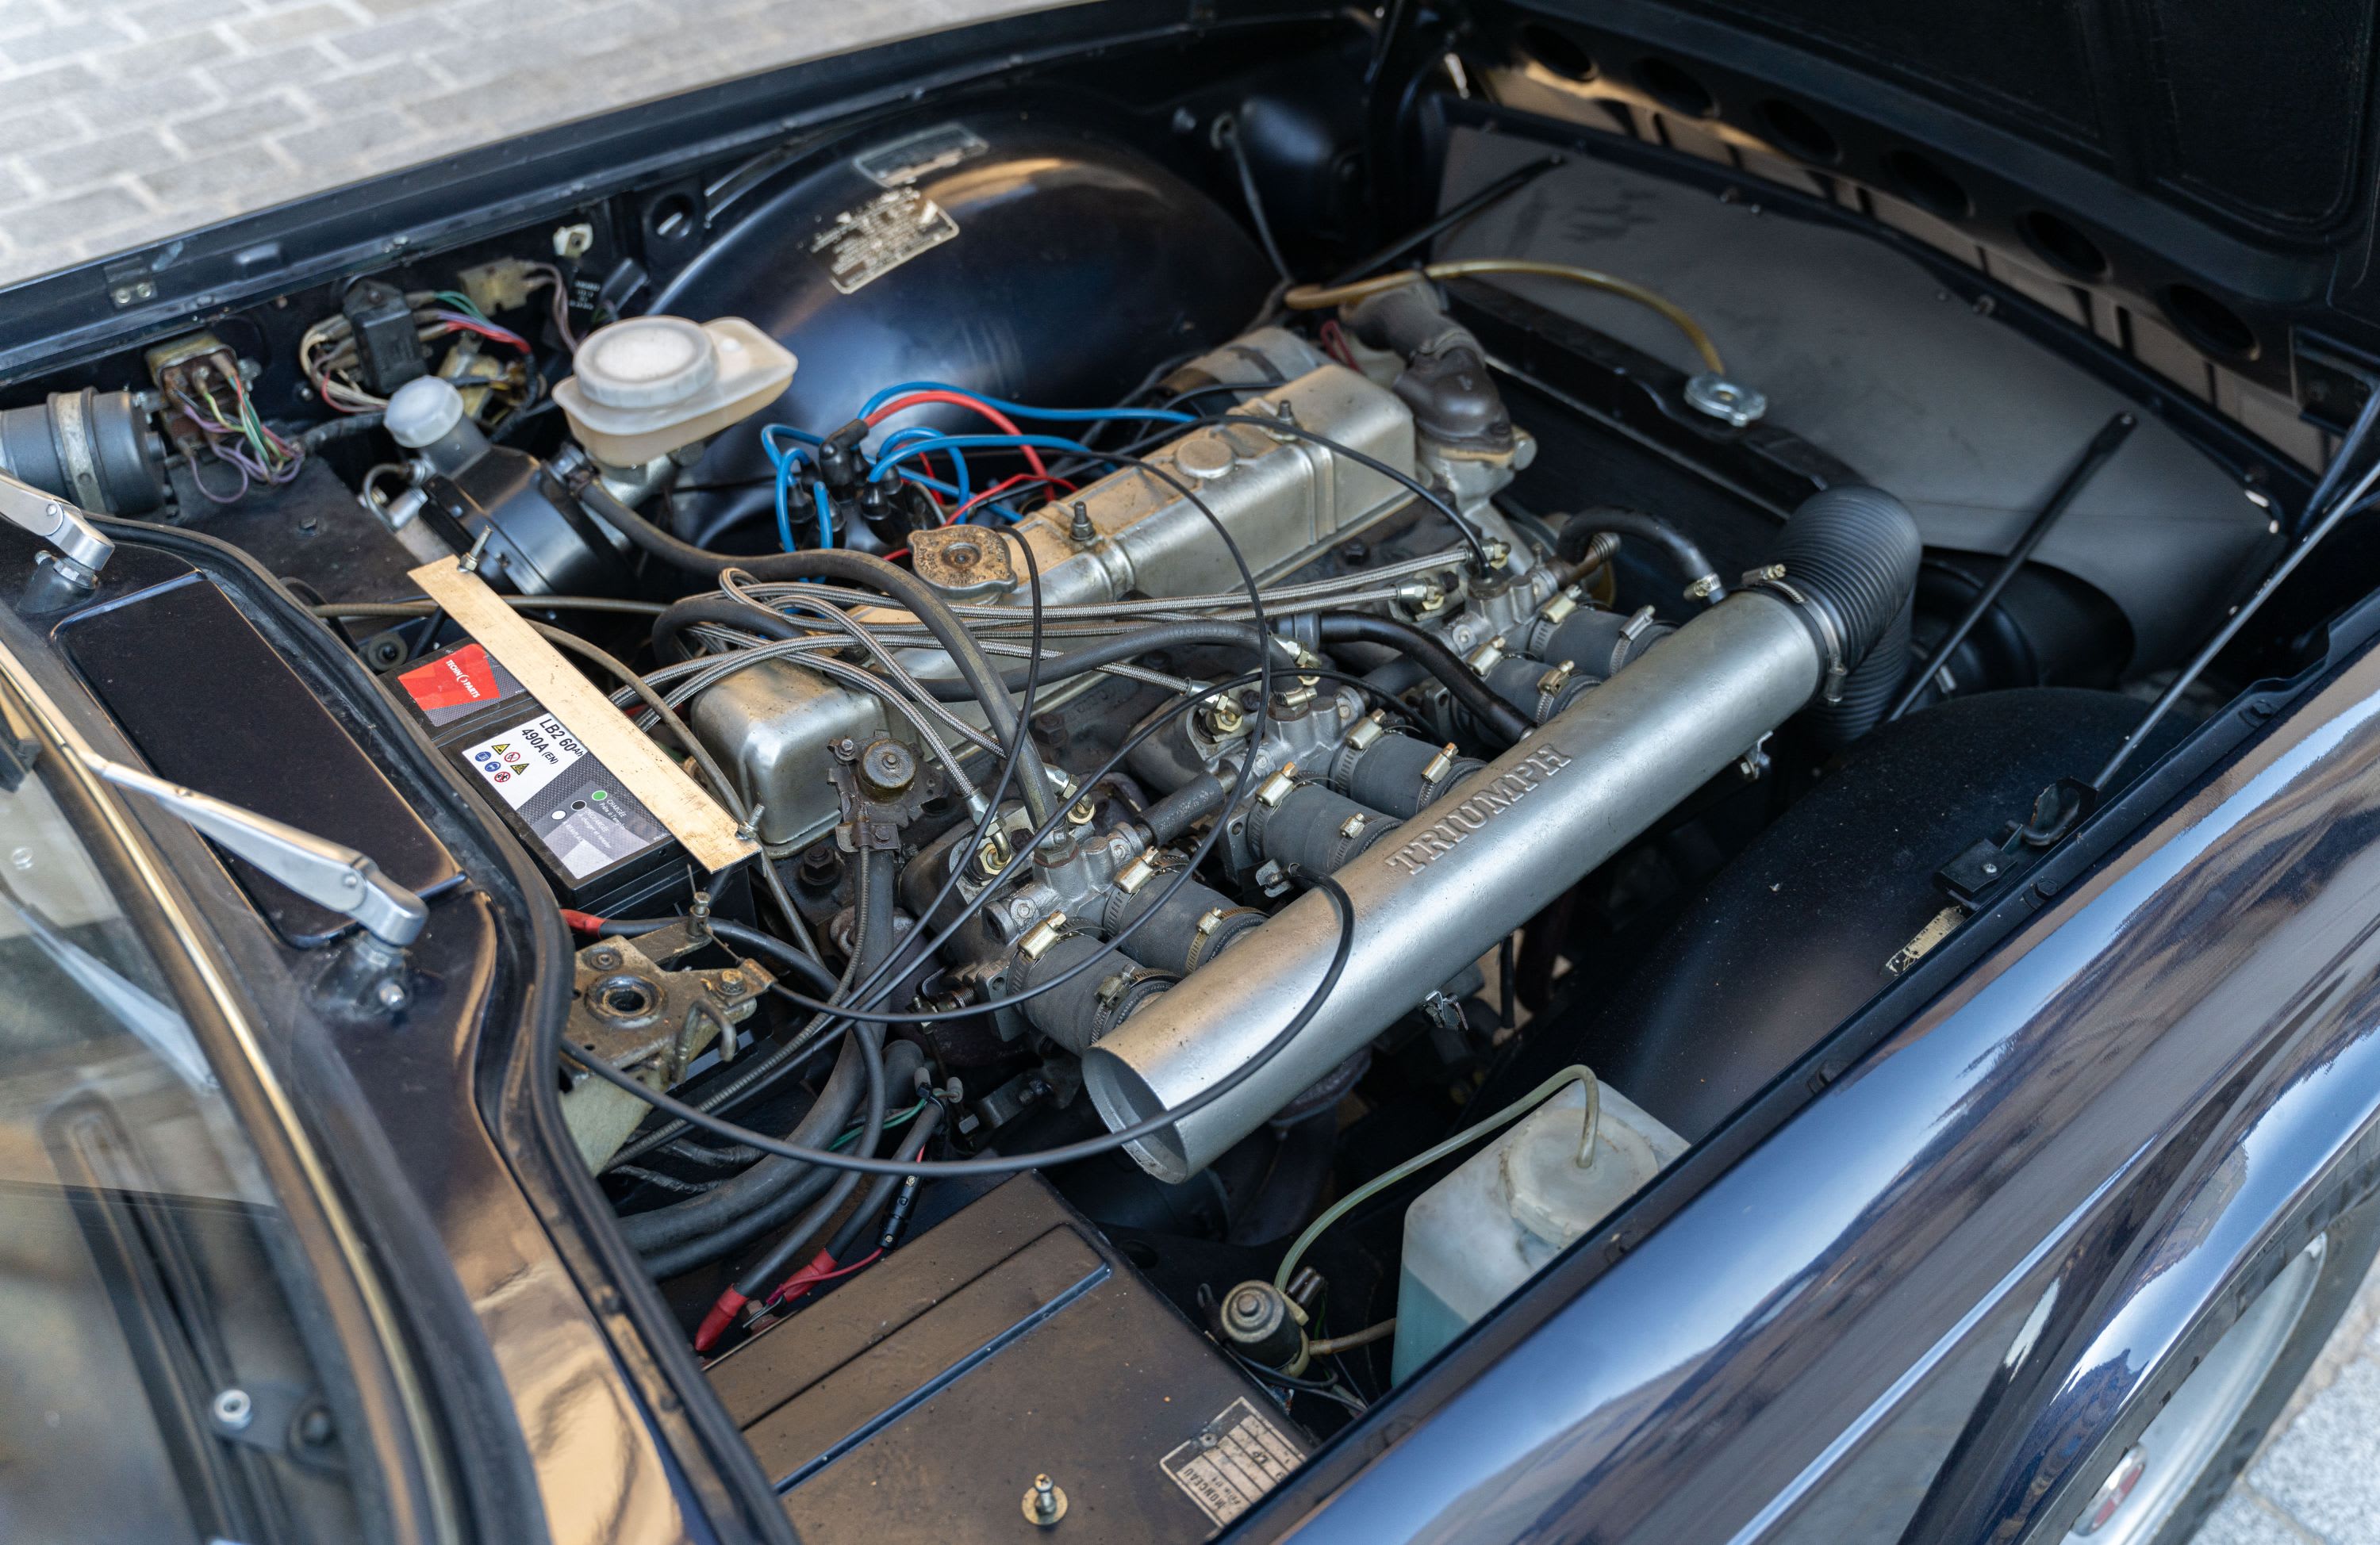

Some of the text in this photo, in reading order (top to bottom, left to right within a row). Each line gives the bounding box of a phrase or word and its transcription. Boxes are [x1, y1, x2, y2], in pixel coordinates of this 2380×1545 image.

[522, 729, 559, 765] 490A (EN)
[539, 719, 566, 739] LB2
[607, 799, 627, 818] CHARGÉE
[1385, 743, 1572, 875] TRIUMPH
[1184, 1468, 1226, 1509] MONCEAU
